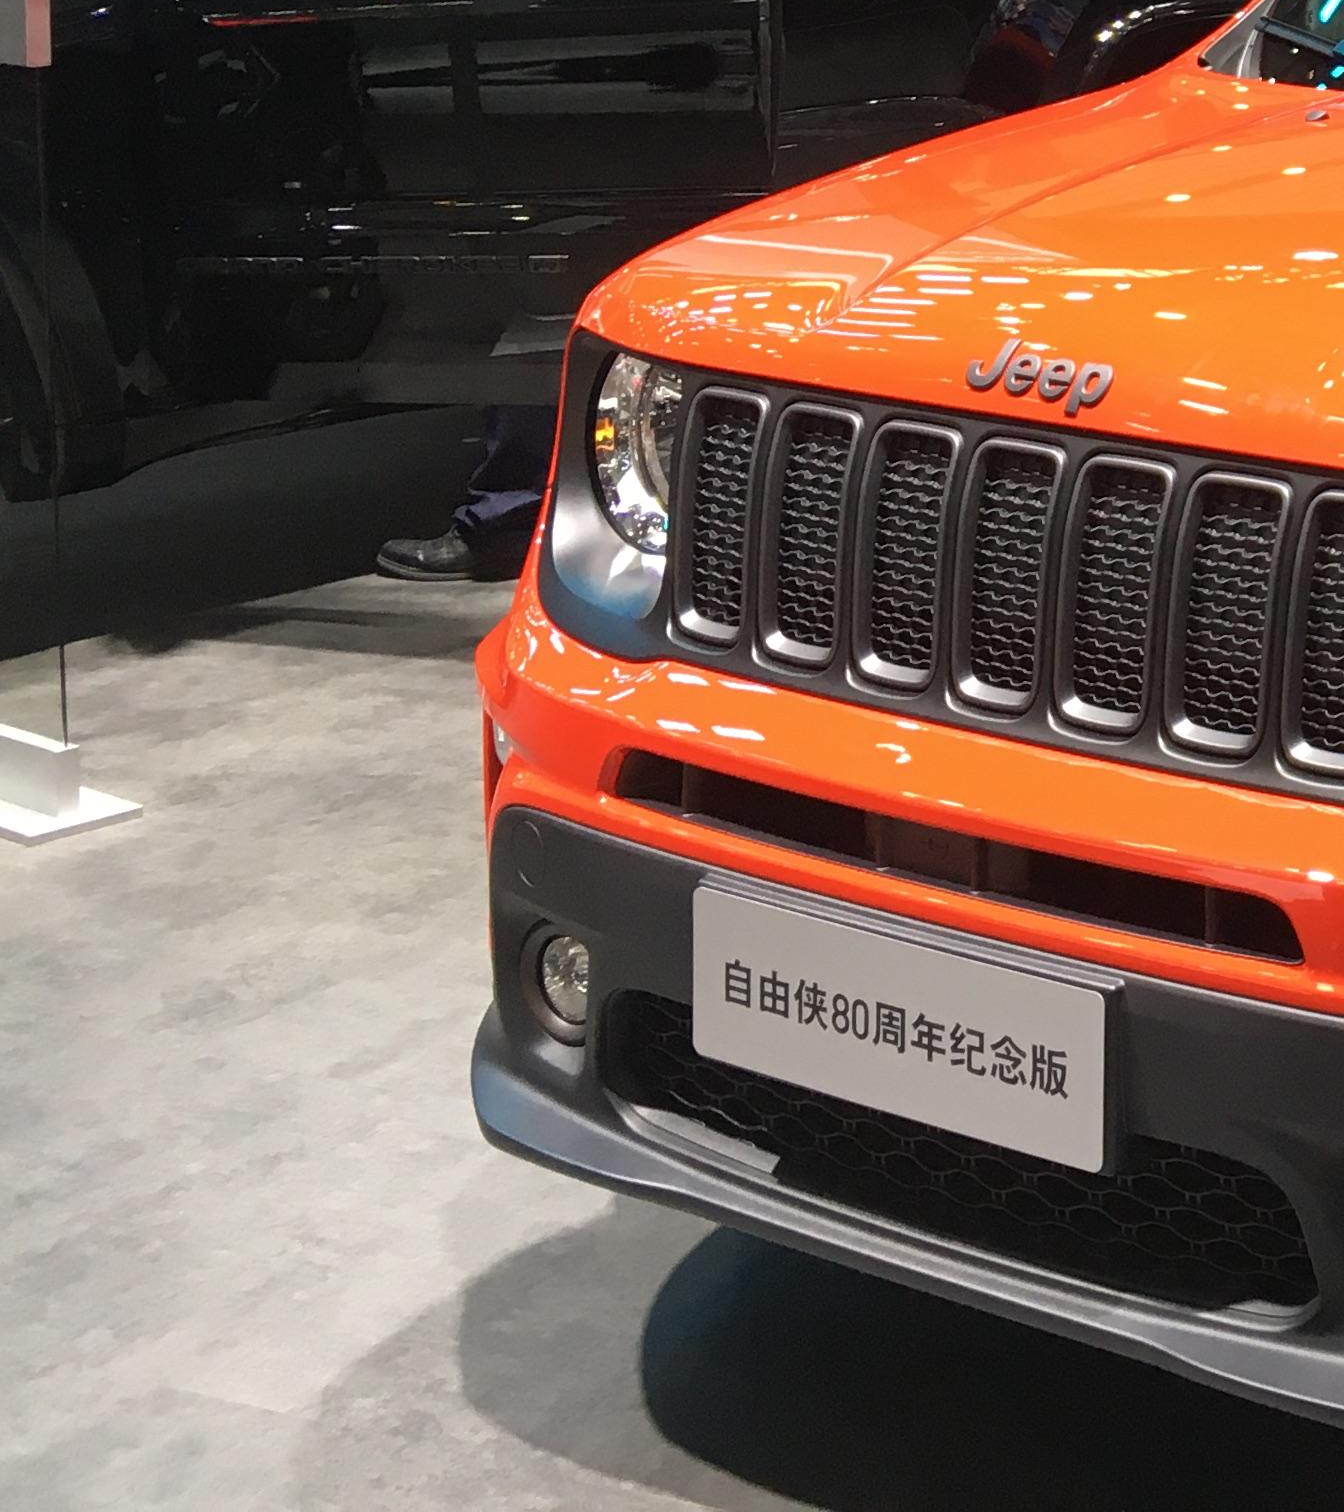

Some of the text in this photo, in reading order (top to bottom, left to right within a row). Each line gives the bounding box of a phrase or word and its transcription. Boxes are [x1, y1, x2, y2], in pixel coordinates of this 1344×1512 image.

[966, 338, 1113, 417] Jeep
[723, 959, 1069, 1099] 自由侠80周年纪念版
